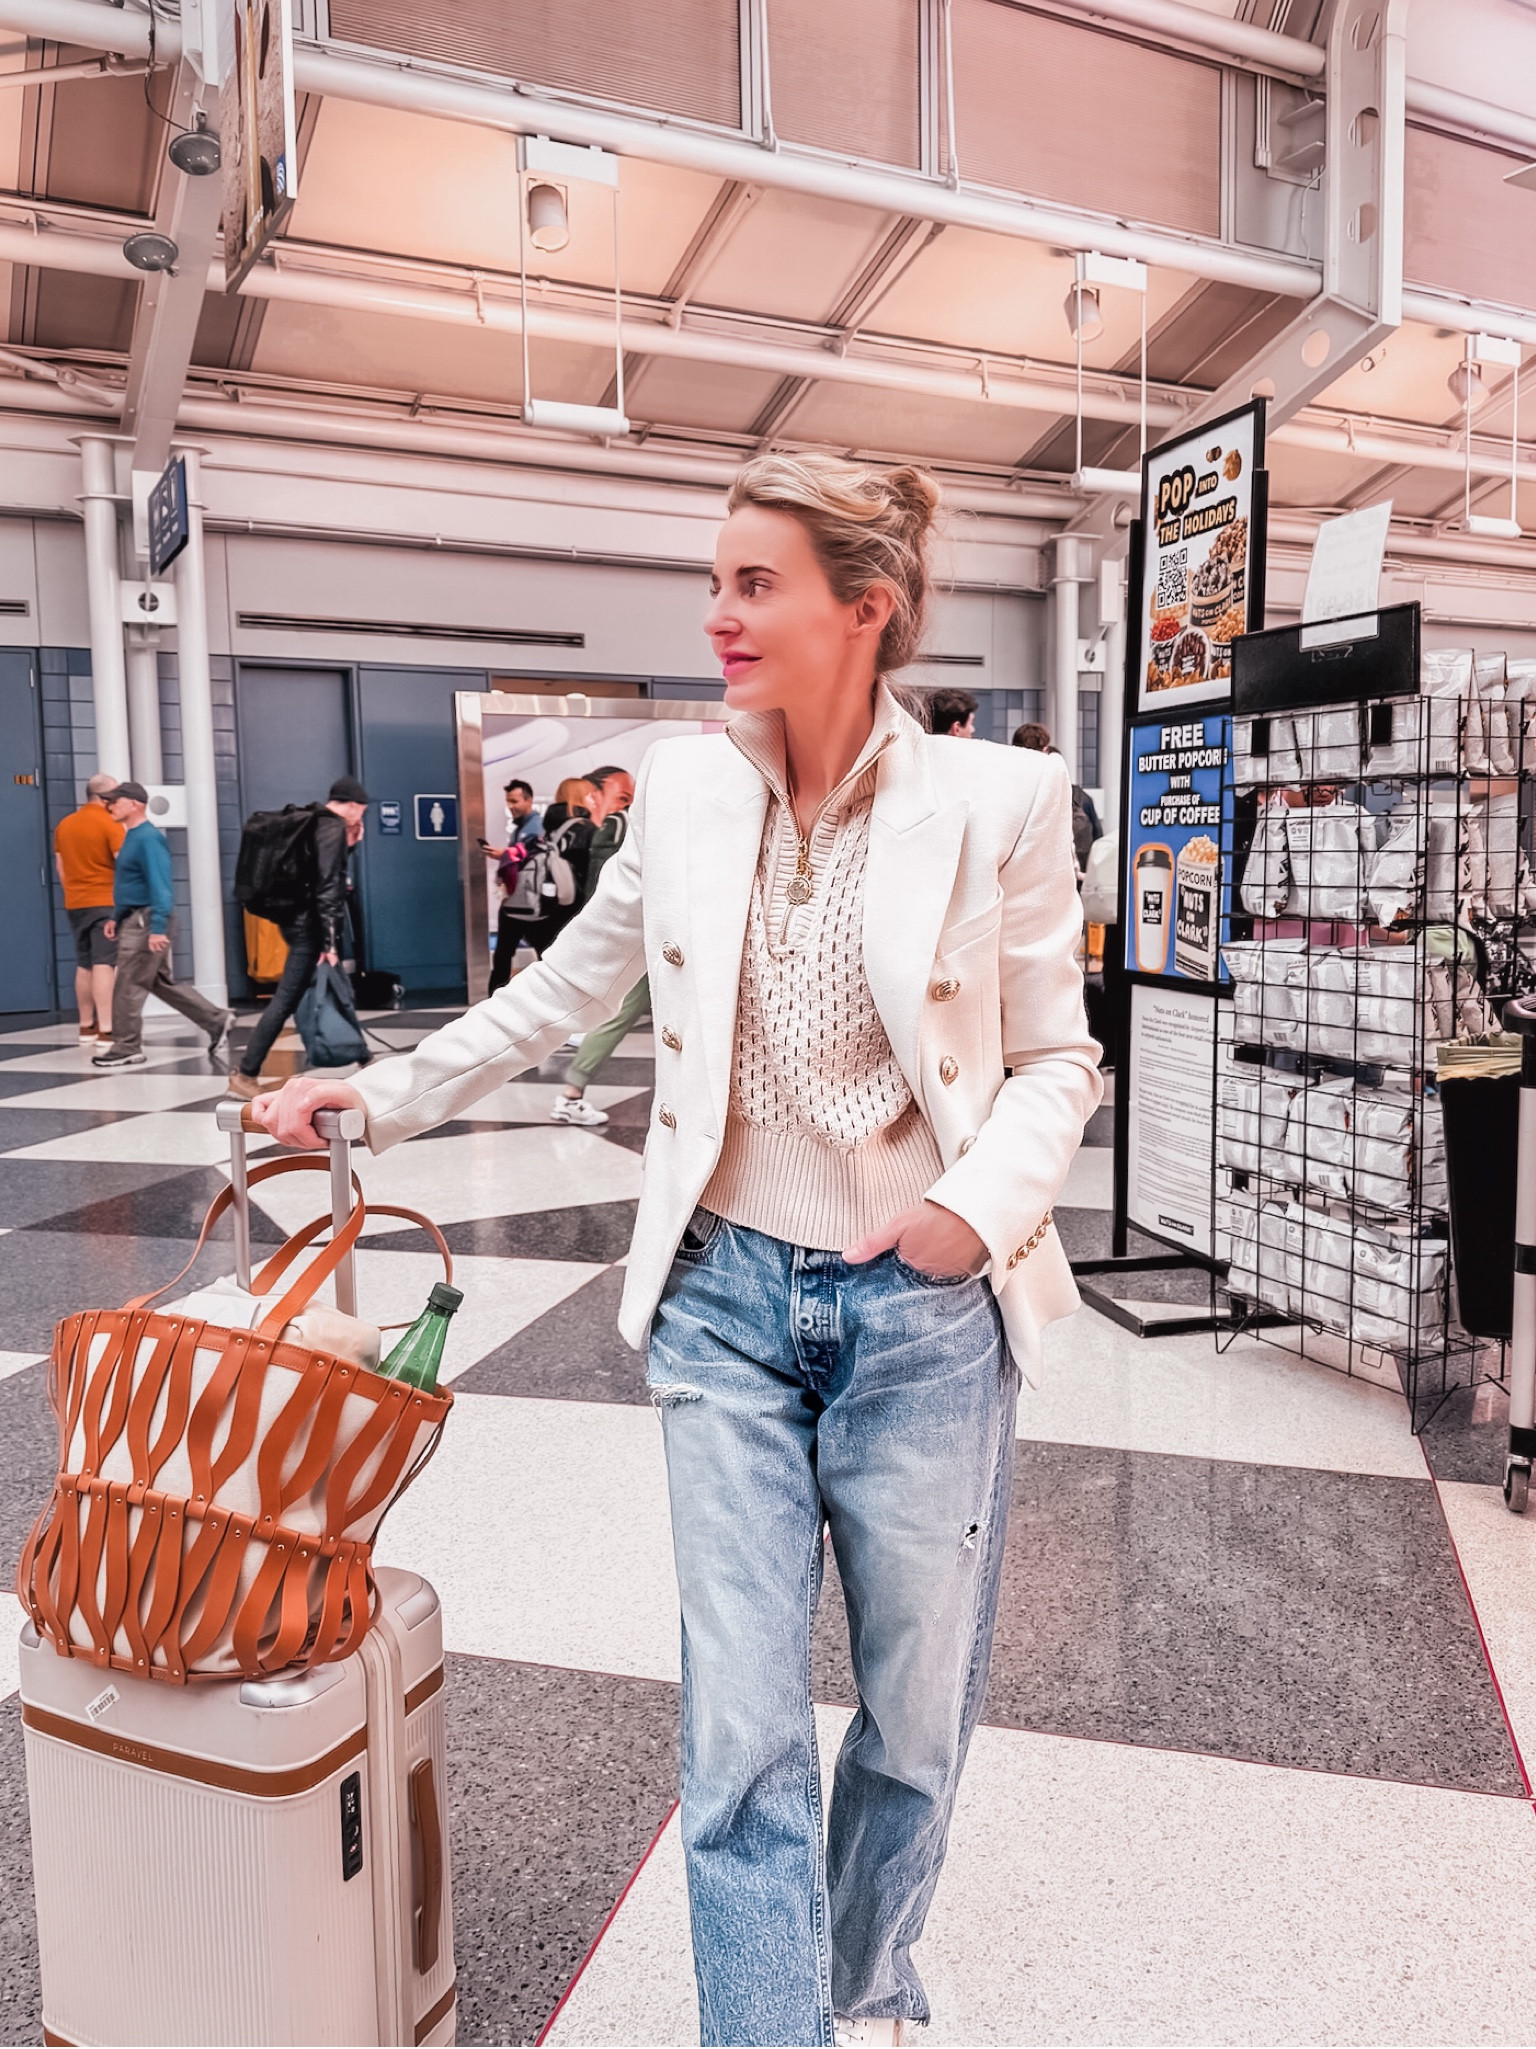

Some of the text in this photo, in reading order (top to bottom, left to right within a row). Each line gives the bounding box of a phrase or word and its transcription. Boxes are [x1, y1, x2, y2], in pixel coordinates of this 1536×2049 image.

[1160, 472, 1218, 513] POP INTO
[1160, 499, 1235, 545] THE HOLIDAYS
[1161, 723, 1204, 749] FREE
[1138, 753, 1177, 772] BUTTER
[1170, 774, 1191, 789] WITH
[1161, 794, 1201, 807] PURCHASE OF
[1140, 806, 1220, 825] CUP OF COFFEE
[1178, 868, 1212, 887] POPCORN
[112, 1742, 154, 1762] PARAVEL
